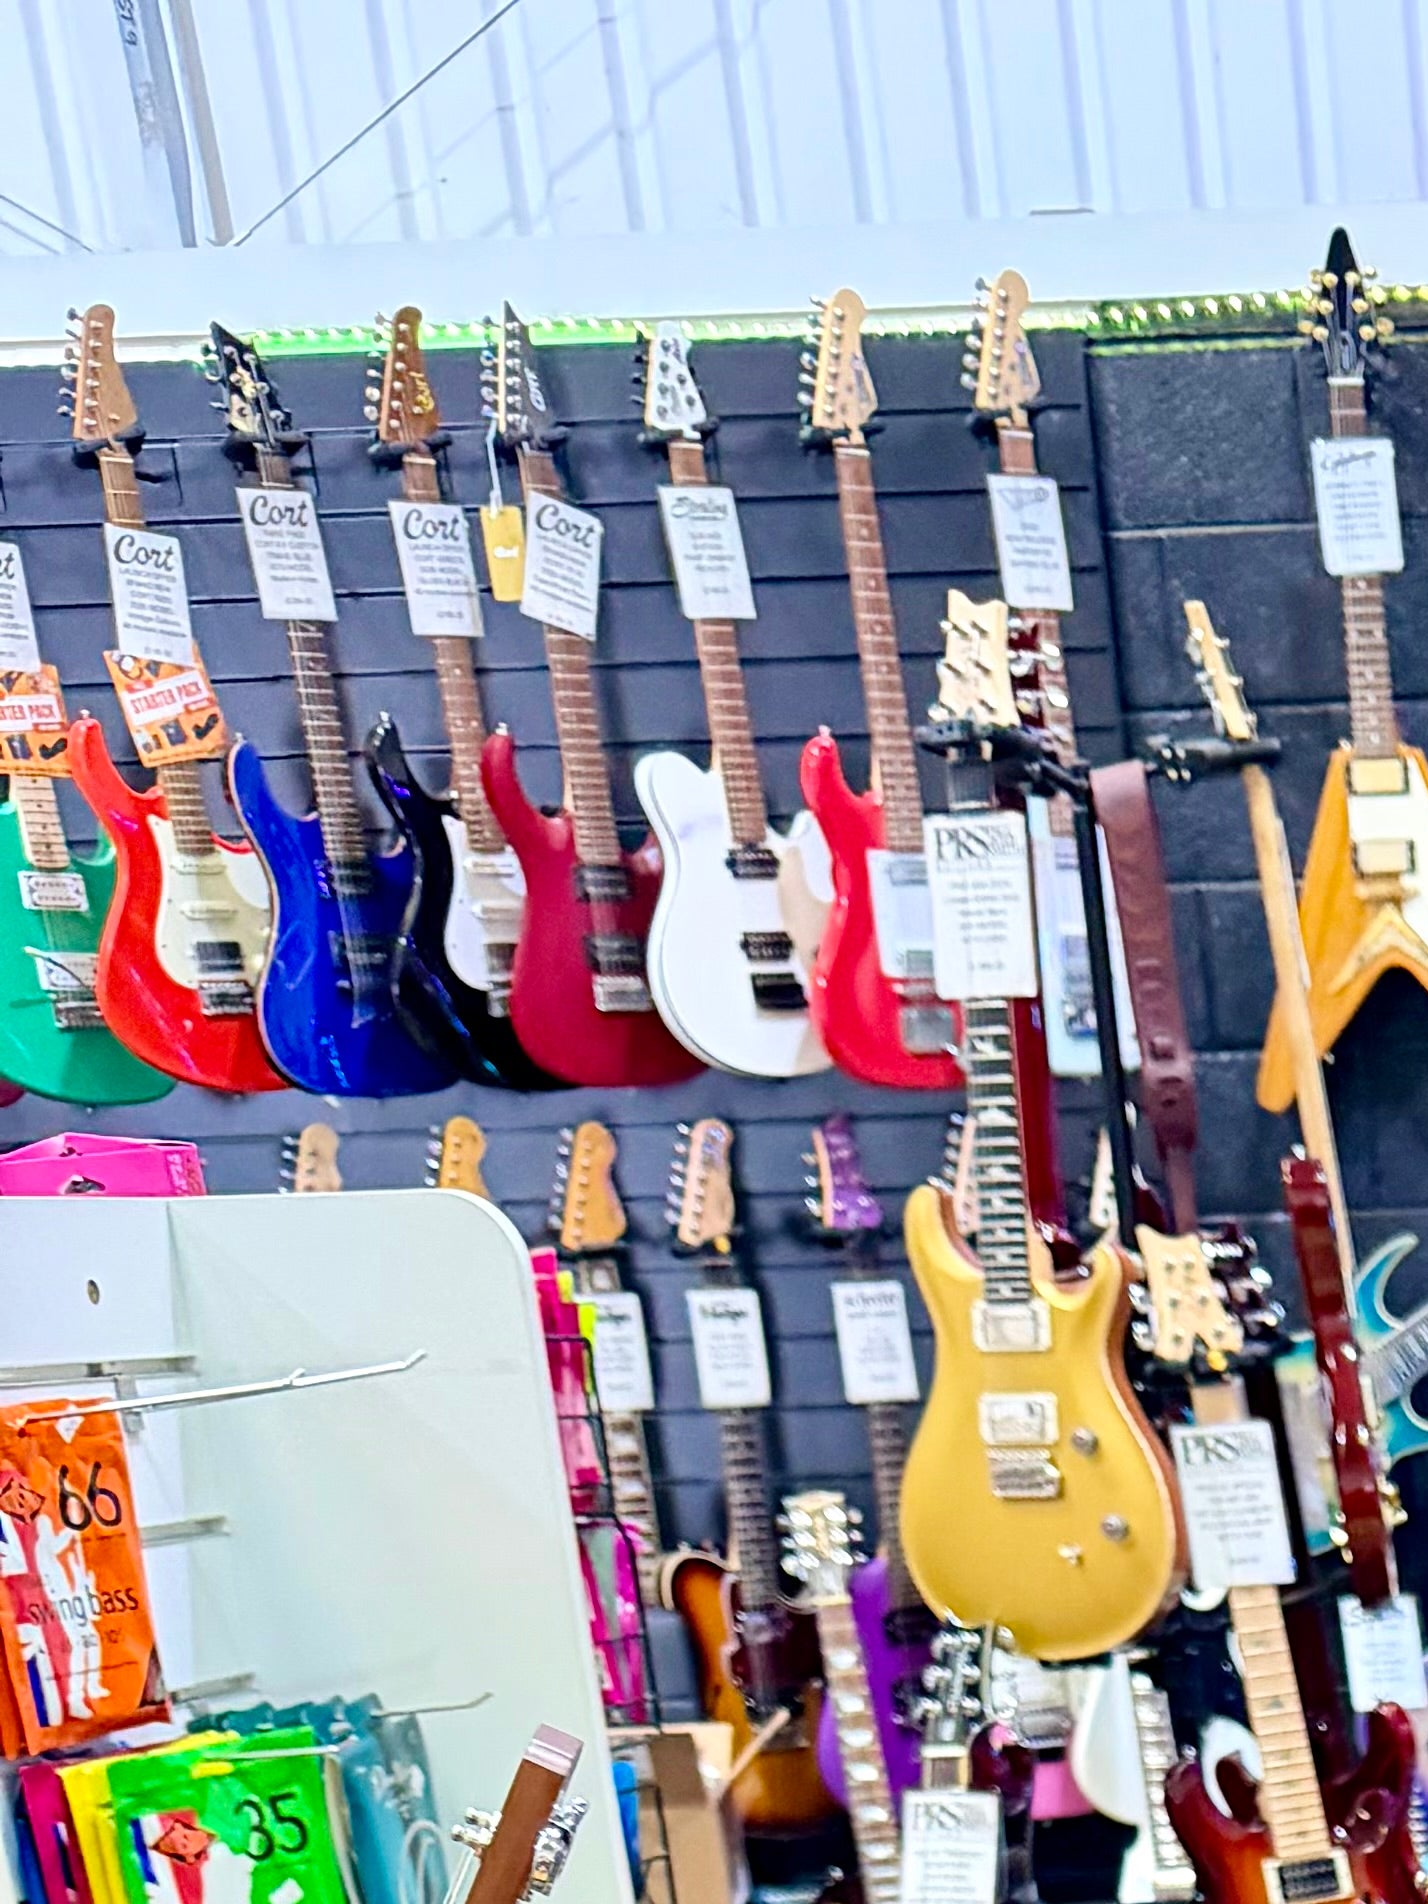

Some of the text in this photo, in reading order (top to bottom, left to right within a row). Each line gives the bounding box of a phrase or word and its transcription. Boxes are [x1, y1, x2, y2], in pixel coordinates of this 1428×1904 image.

[249, 494, 310, 528] Cort
[402, 508, 461, 543] Cort
[534, 502, 596, 549] Cort
[113, 534, 176, 572] Cort
[130, 679, 204, 715] STARTER PACK
[58, 1460, 123, 1532] 66
[84, 1583, 139, 1615] bass
[233, 1792, 308, 1862] 35
